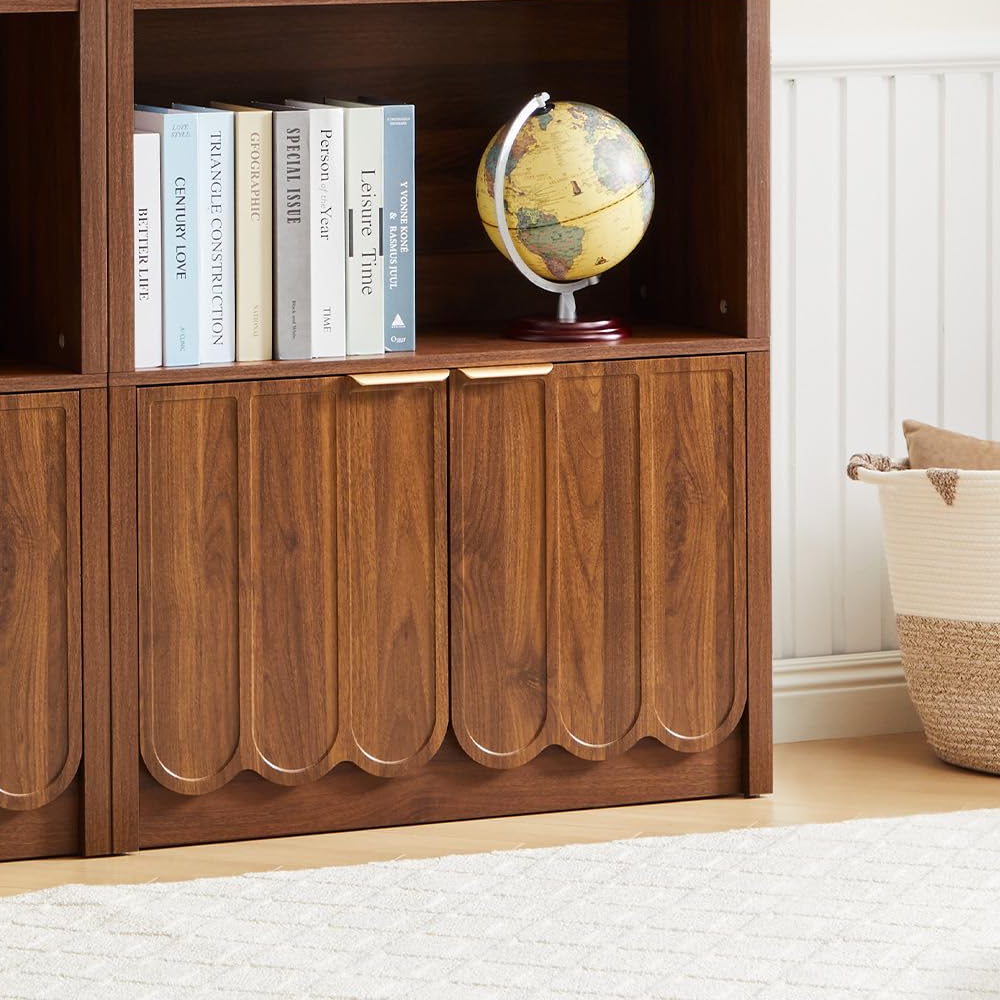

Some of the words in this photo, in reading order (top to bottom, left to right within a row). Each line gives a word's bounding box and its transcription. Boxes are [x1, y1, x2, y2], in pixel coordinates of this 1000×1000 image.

[210, 130, 223, 214] TRIANGLE
[250, 131, 260, 222] GEOGRAPHIC
[286, 127, 301, 182] SPECIAL
[320, 129, 333, 182] Person
[174, 176, 186, 241] CENTURY
[286, 188, 301, 224] ISSUE
[319, 206, 332, 240] Year
[361, 169, 376, 237] Leisure
[389, 211, 397, 220] &
[138, 208, 149, 264] BETTER
[388, 225, 398, 266] RASMUS
[138, 269, 149, 301] LIFE
[175, 245, 187, 280] LOVE
[210, 217, 224, 346] CONSTRUCTION
[361, 247, 377, 295] Time
[388, 266, 398, 290] JUUL
[323, 305, 332, 333] TIME
